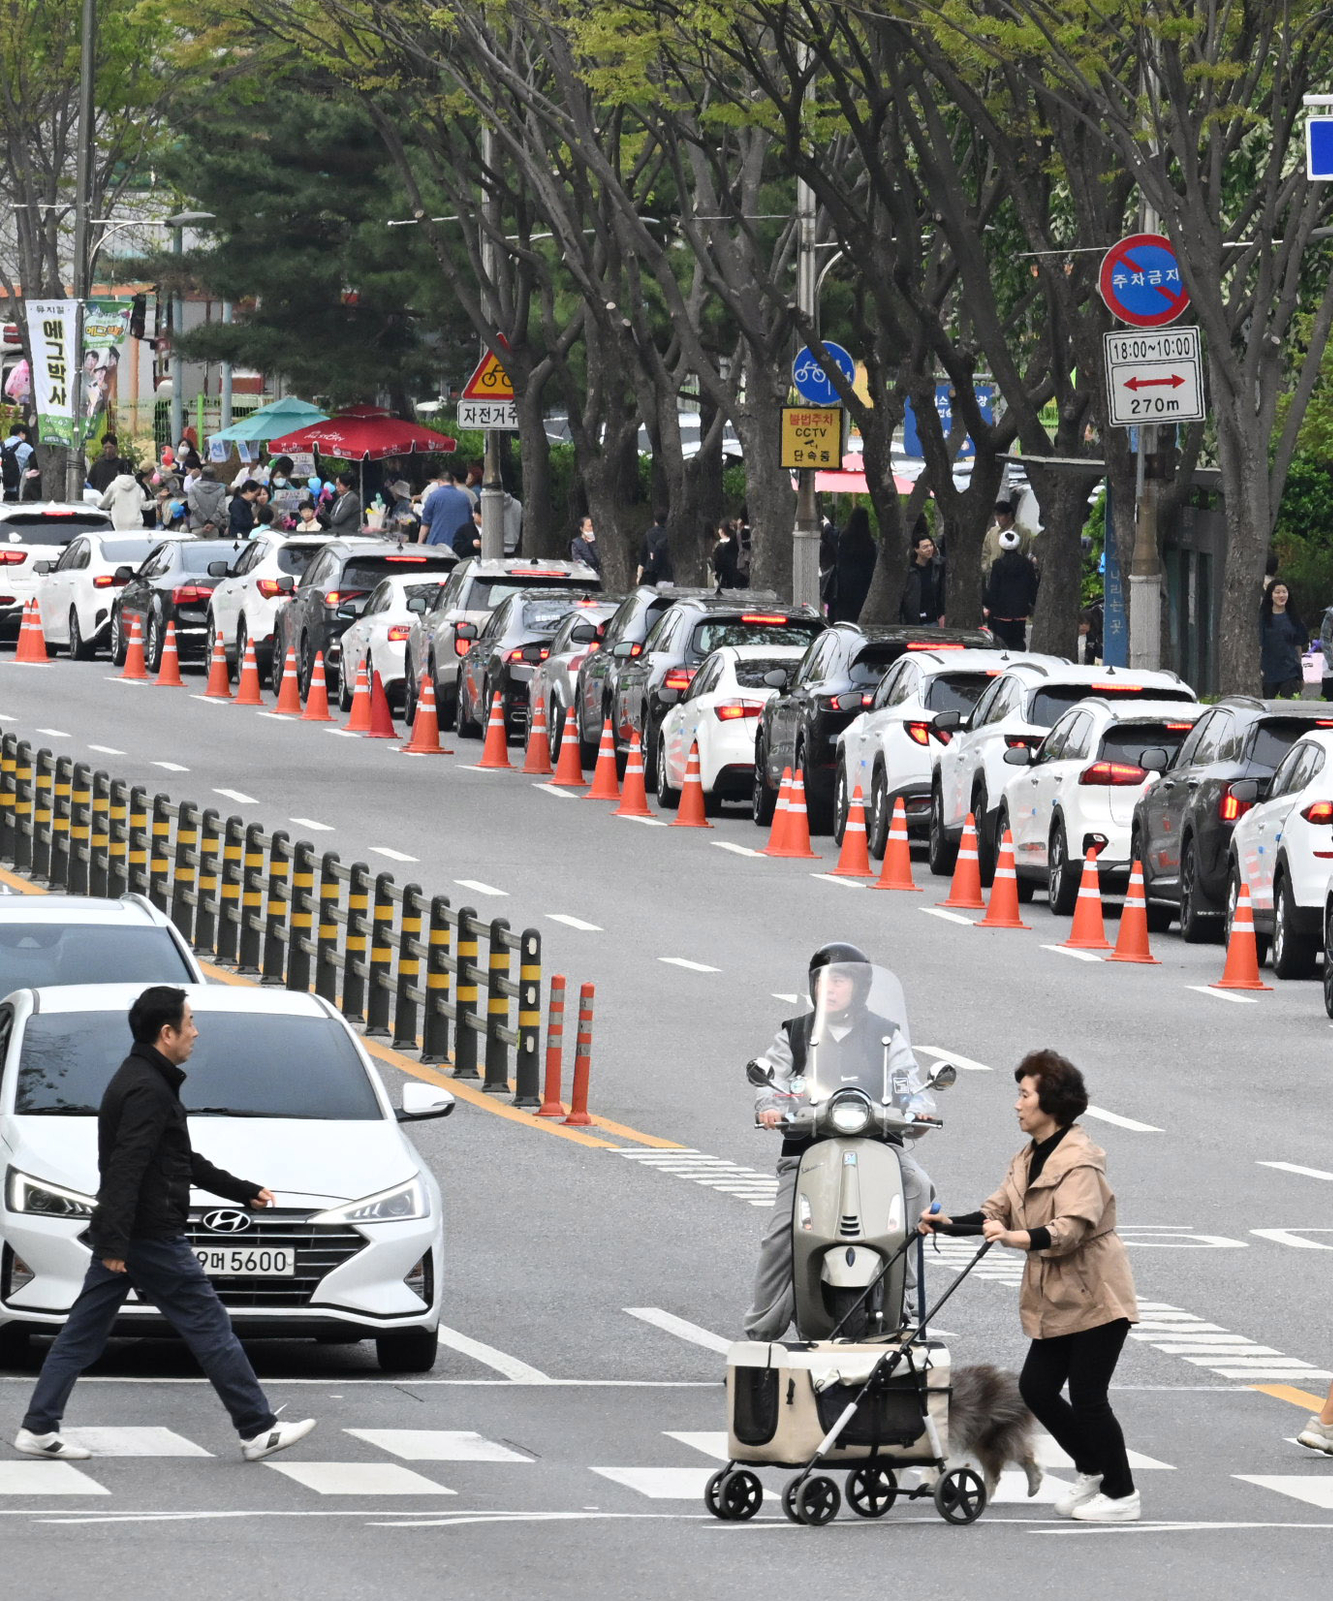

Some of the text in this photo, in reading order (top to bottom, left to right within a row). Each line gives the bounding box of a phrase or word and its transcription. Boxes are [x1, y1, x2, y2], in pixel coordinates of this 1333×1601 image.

[1112, 267, 1181, 290] 주차금지
[1114, 336, 1190, 360] 18:00~10:00
[43, 319, 67, 407] 에그박사
[1130, 398, 1180, 414] 270m
[795, 427, 827, 438] CCTV
[230, 1251, 287, 1272] 5600
